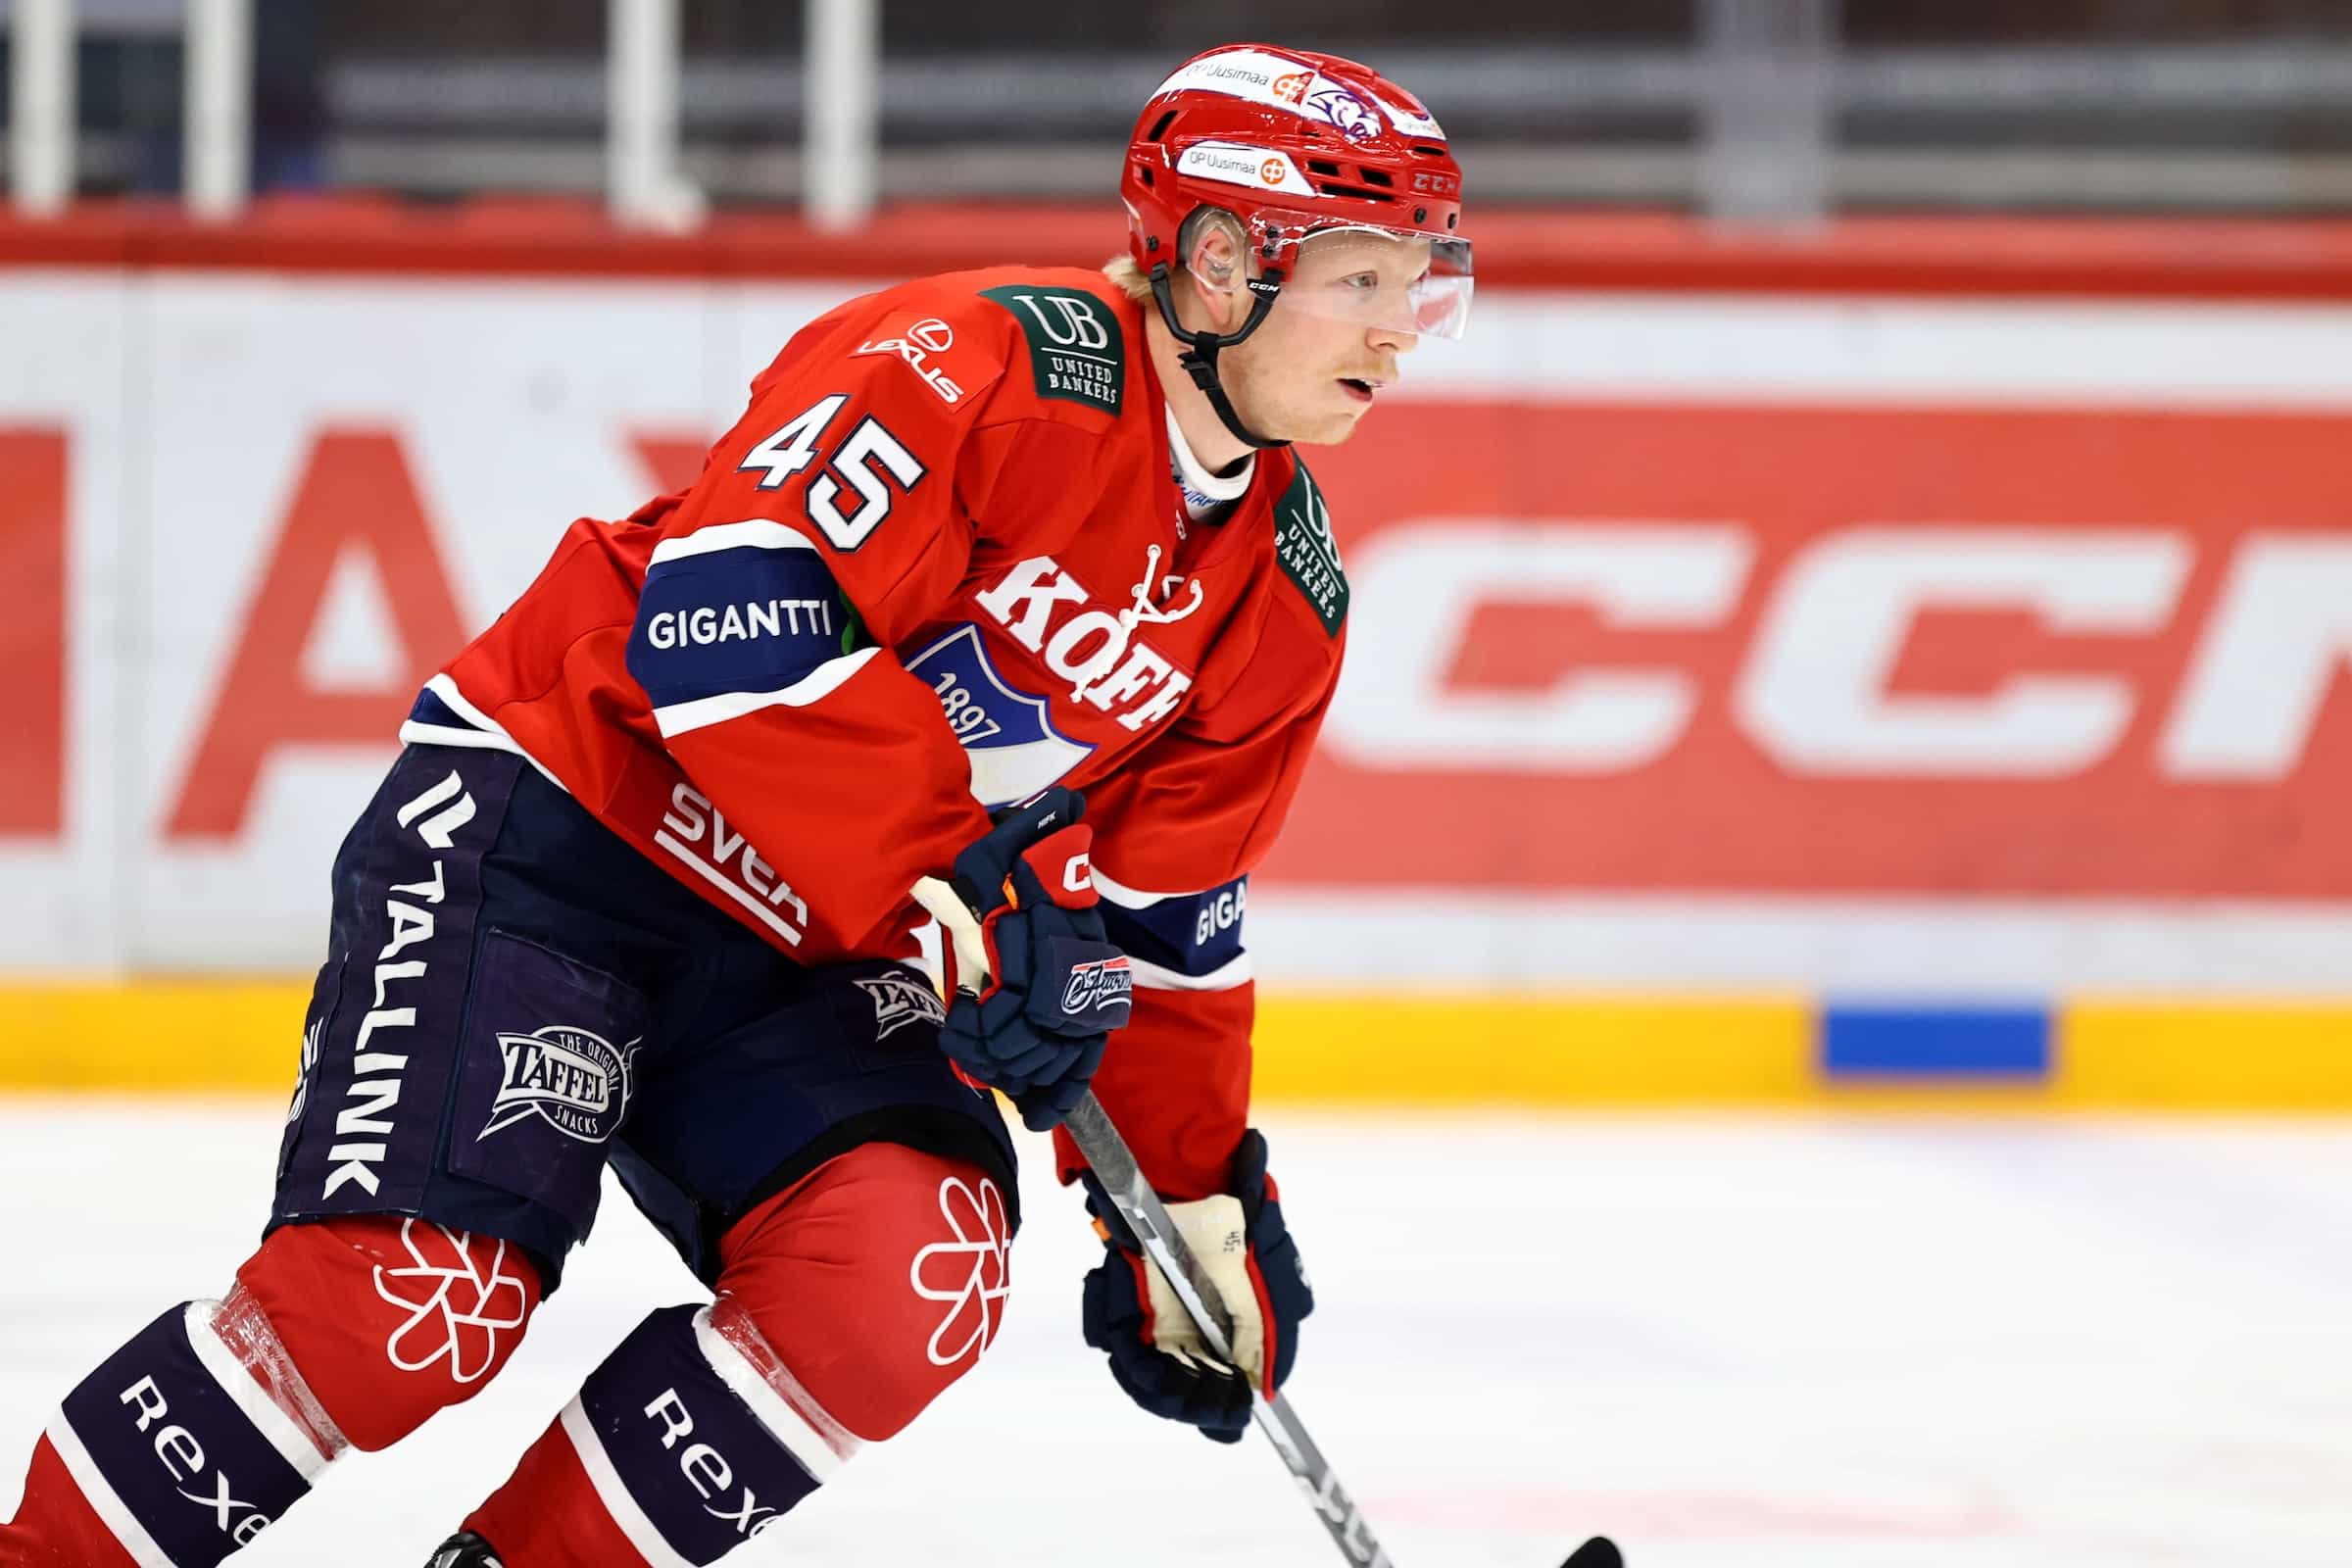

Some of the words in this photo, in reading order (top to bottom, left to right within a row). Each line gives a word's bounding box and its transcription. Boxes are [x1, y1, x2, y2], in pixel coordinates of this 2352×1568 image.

[1190, 151, 1205, 164] OP
[1207, 154, 1255, 174] Uusimaa
[1249, 281, 1279, 292] CCM
[1012, 295, 1108, 349] UB
[857, 339, 964, 404] LEXUS
[1048, 373, 1117, 404] BANKERS
[1051, 357, 1112, 383] UNITED
[735, 394, 930, 554] 45
[1275, 530, 1336, 619] BANKERS
[1288, 523, 1337, 599] UNITED
[648, 600, 832, 650] GIGANTTI
[934, 672, 1002, 745] 1897
[662, 783, 808, 927] SVEA
[322, 859, 445, 1201] TALLINK
[504, 1042, 606, 1103] TAFFEL
[559, 1034, 582, 1053] THE
[588, 1041, 620, 1094] ORIGINAL
[555, 1104, 599, 1135] SNACKS
